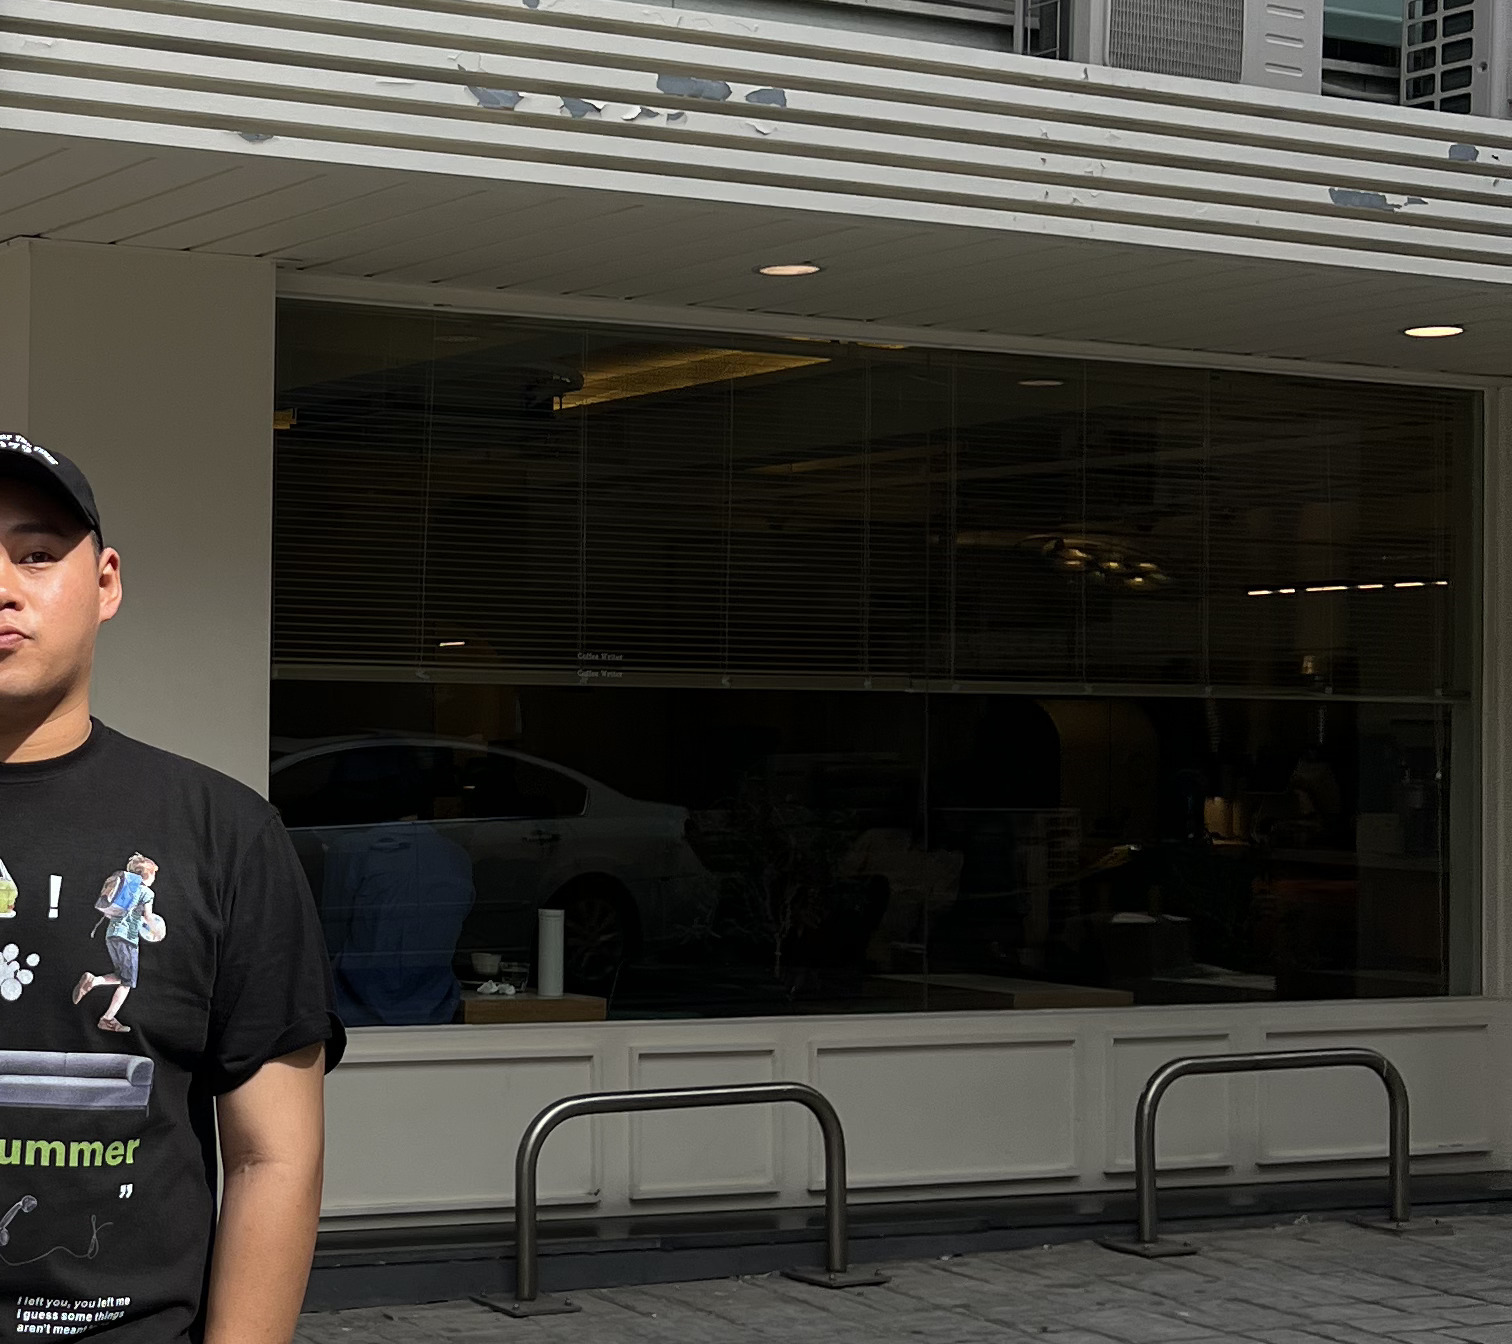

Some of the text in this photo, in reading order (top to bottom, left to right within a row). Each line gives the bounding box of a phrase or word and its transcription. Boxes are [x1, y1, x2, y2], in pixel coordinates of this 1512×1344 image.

[45, 1299, 71, 1309] you,
[74, 1300, 95, 1310] you
[97, 1297, 114, 1308] left
[116, 1297, 131, 1306] me
[22, 1311, 59, 1321] guess
[61, 1312, 93, 1322] some
[94, 1311, 125, 1322] things
[16, 1324, 50, 1334] aren't
